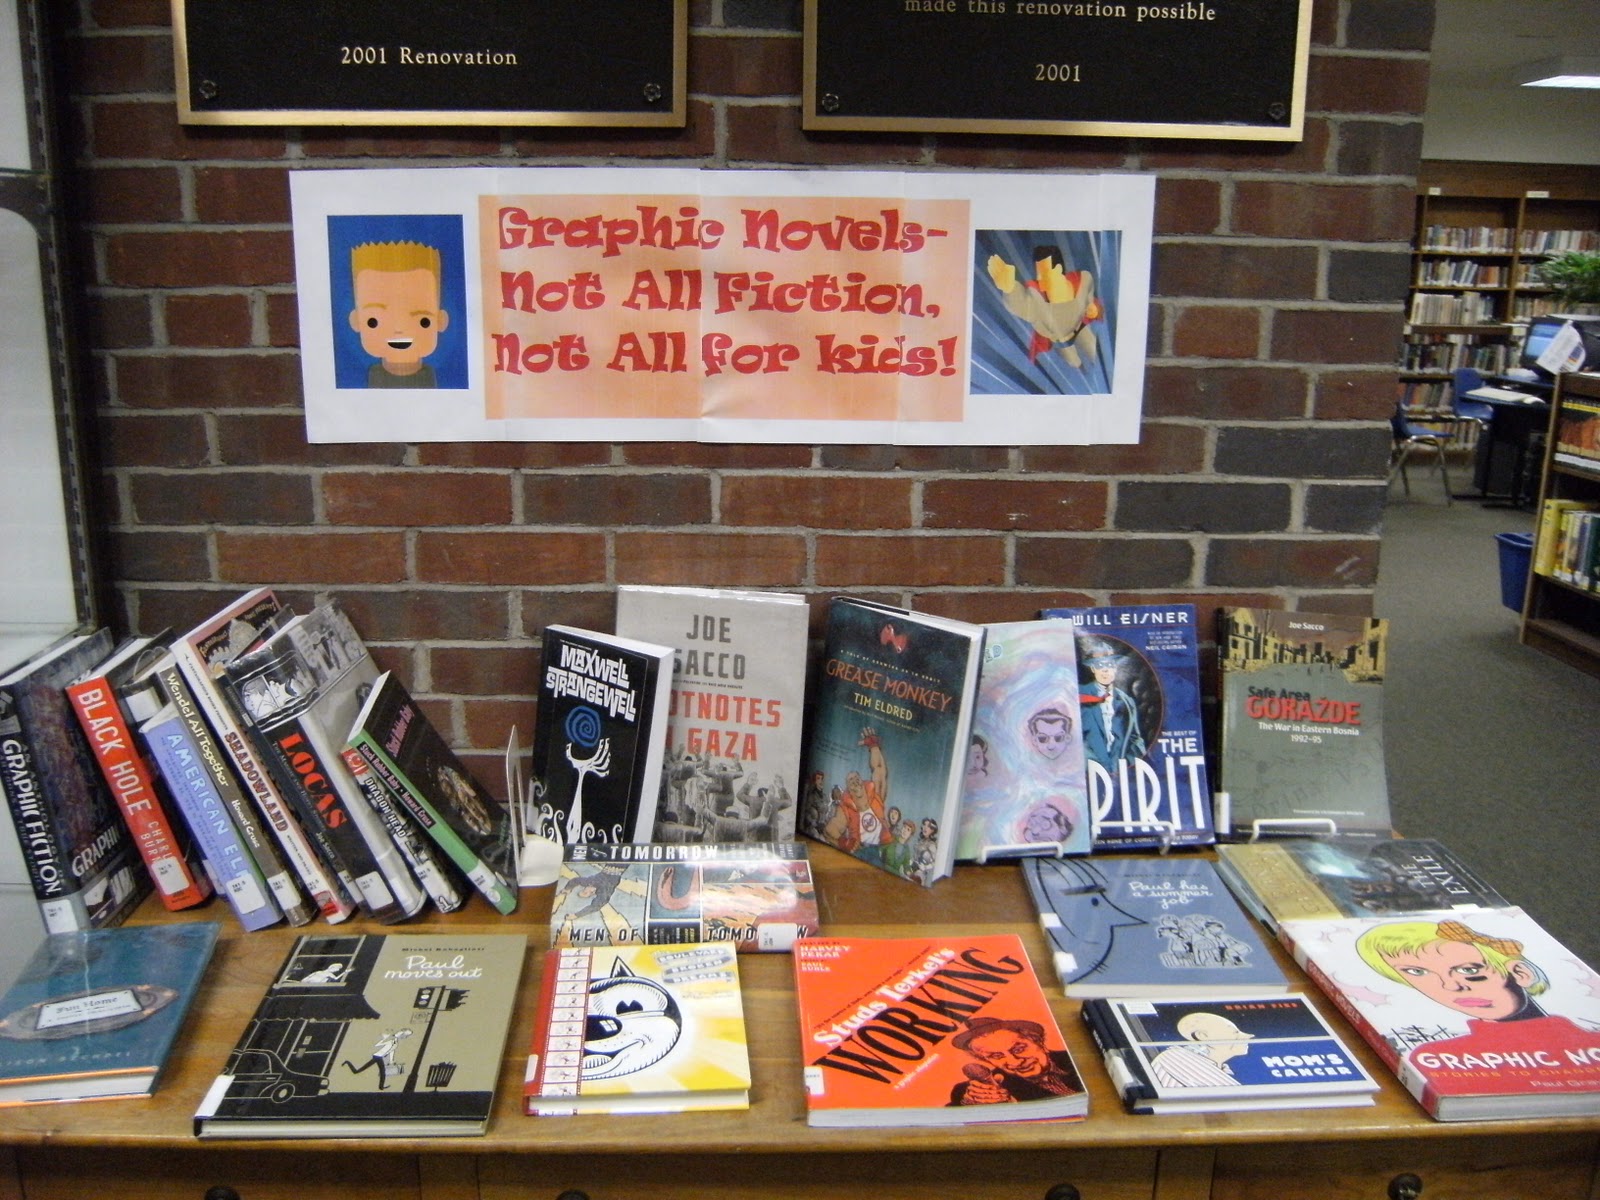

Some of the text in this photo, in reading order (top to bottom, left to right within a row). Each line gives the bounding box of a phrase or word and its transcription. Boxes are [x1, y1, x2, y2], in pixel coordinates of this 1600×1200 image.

[905, 0, 1216, 22] made this renovation possible
[341, 46, 518, 66] 2001 Renovation
[1035, 63, 1081, 83] 2001
[499, 205, 948, 258] Graphic Novels-
[501, 269, 940, 318] Not All Fiction,
[491, 331, 957, 377] Not All for kids!
[686, 615, 731, 643] JOE
[1072, 611, 1188, 626] WILL EISNER
[1288, 621, 1324, 631] Joe Sacco
[560, 644, 629, 689] MAXWELL
[673, 649, 745, 680] SACCO
[545, 665, 637, 722] STRANGEWELL
[826, 659, 952, 712] GREASE MONKEY
[1248, 685, 1311, 701] Safe Area
[668, 689, 781, 728] OTNOTES
[854, 692, 872, 707] TIM
[874, 700, 913, 721] ELDRED
[1246, 695, 1361, 725] GORAŽDE
[166, 672, 229, 787] Wendel All Together
[1258, 722, 1359, 736] The War in Eastern Bosnia
[78, 688, 152, 816] BLACK HOLE
[687, 728, 758, 761] GAZA
[1158, 738, 1198, 753] THE
[2, 739, 40, 817] GRAPHIC
[167, 734, 228, 835] AMERICAN
[224, 731, 289, 832] SHADOWLAND
[278, 732, 347, 829] LOCAS
[360, 744, 433, 826] Stuck Rubber Baby Howard Cruse
[364, 777, 406, 838] DRAGON HEAD
[1088, 756, 1205, 834] PIRIT
[231, 799, 260, 848] Howard Cruse
[72, 826, 119, 877] GRAPHI
[141, 833, 161, 861] BUR
[148, 821, 173, 861] CHARL
[573, 845, 588, 860] MEN
[611, 845, 718, 861] TOMORROW
[1129, 880, 1208, 891] Paul has
[1401, 863, 1436, 888] THE
[1412, 855, 1471, 895] EXILE
[439, 896, 453, 911] 1
[1160, 896, 1194, 909] job
[569, 928, 605, 942] MEN
[618, 928, 639, 941] OF
[708, 926, 808, 942] TOMOW
[384, 967, 483, 979] moves out
[405, 954, 464, 969] Paul
[671, 960, 722, 973] BROKEN
[875, 946, 956, 1002] Terkel's
[673, 972, 726, 983] DREAMS
[56, 1005, 80, 1014] Fun
[82, 997, 118, 1008] Home
[812, 946, 1024, 1085] WORKING
[813, 999, 888, 1048] Studs
[1261, 1053, 1344, 1068] MOM'S
[1271, 1066, 1352, 1078] CANCER
[1416, 1047, 1600, 1070] GRAPHIC NO
[1428, 1070, 1501, 1079] STORIES
